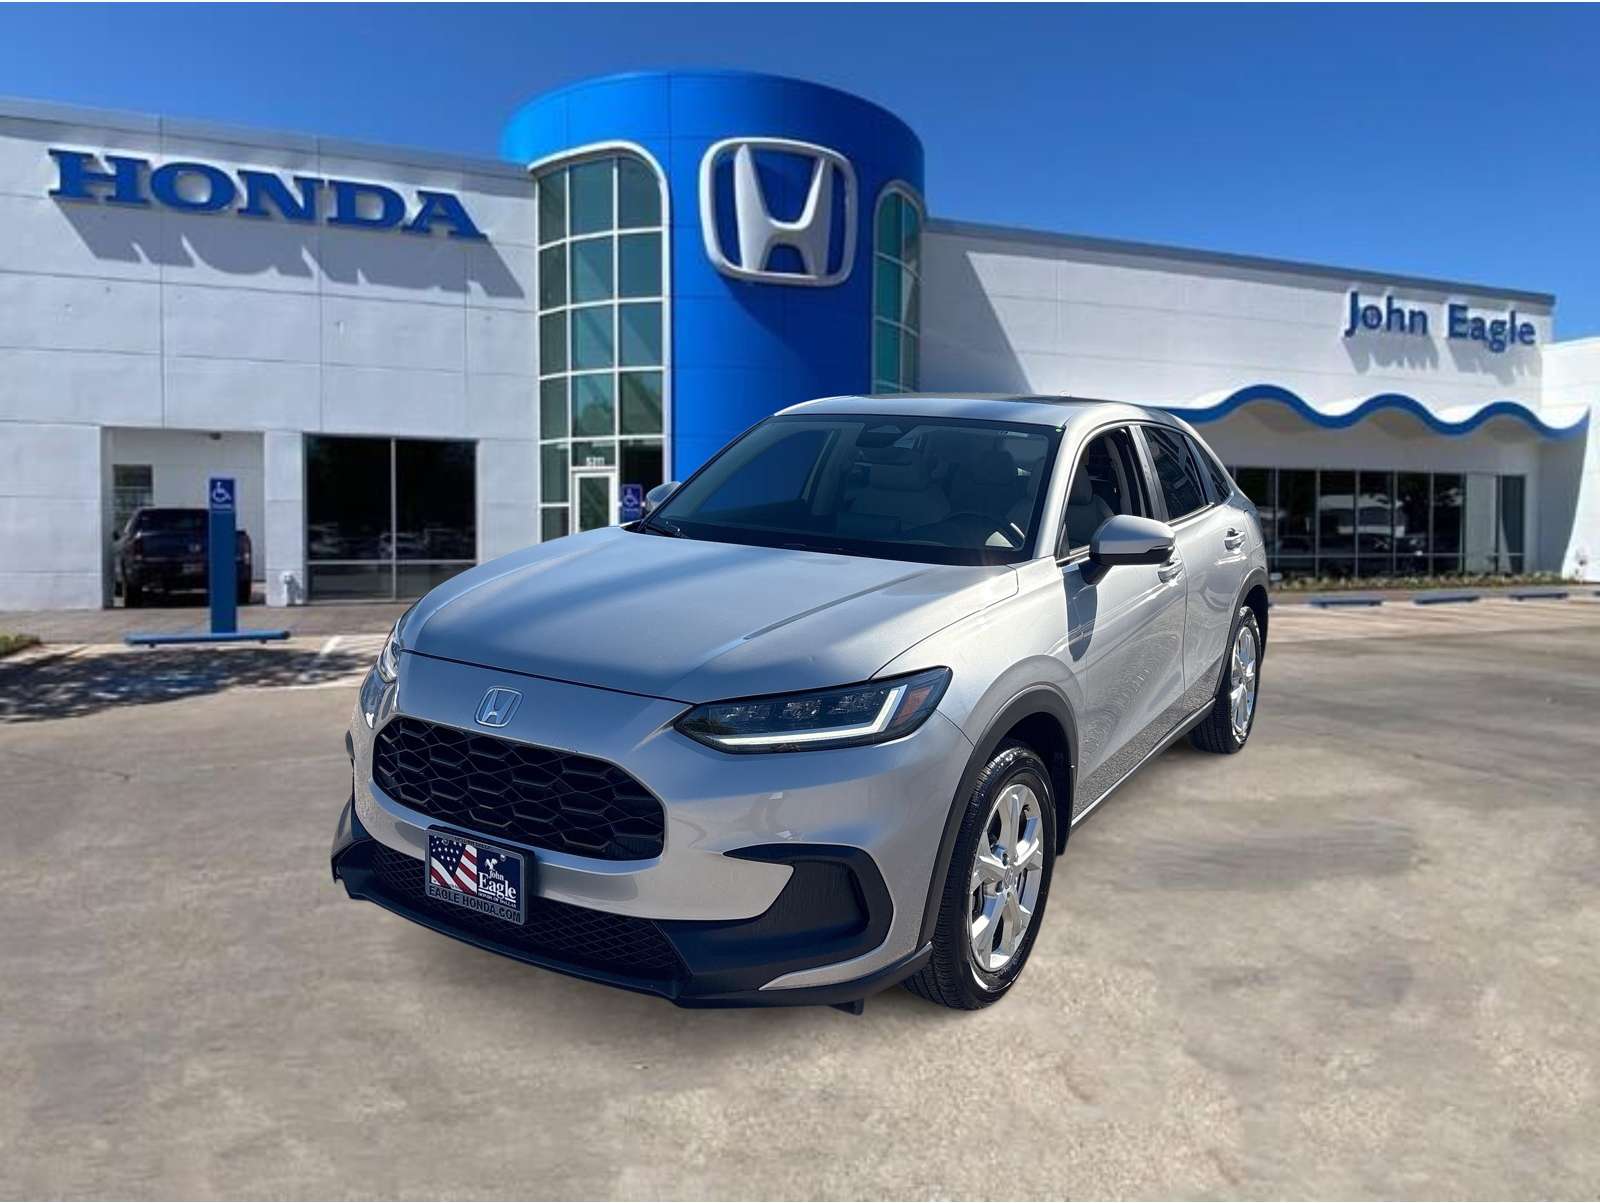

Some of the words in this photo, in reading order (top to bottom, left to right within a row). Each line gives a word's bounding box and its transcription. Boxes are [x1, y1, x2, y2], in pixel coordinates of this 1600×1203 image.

[48, 147, 488, 242] HONDA
[1344, 291, 1428, 337] John
[1448, 303, 1536, 353] Eagle
[478, 871, 517, 900] Eagle
[489, 870, 504, 881] John
[429, 886, 460, 903] EAGLE
[462, 896, 521, 923] HONDA.COM
